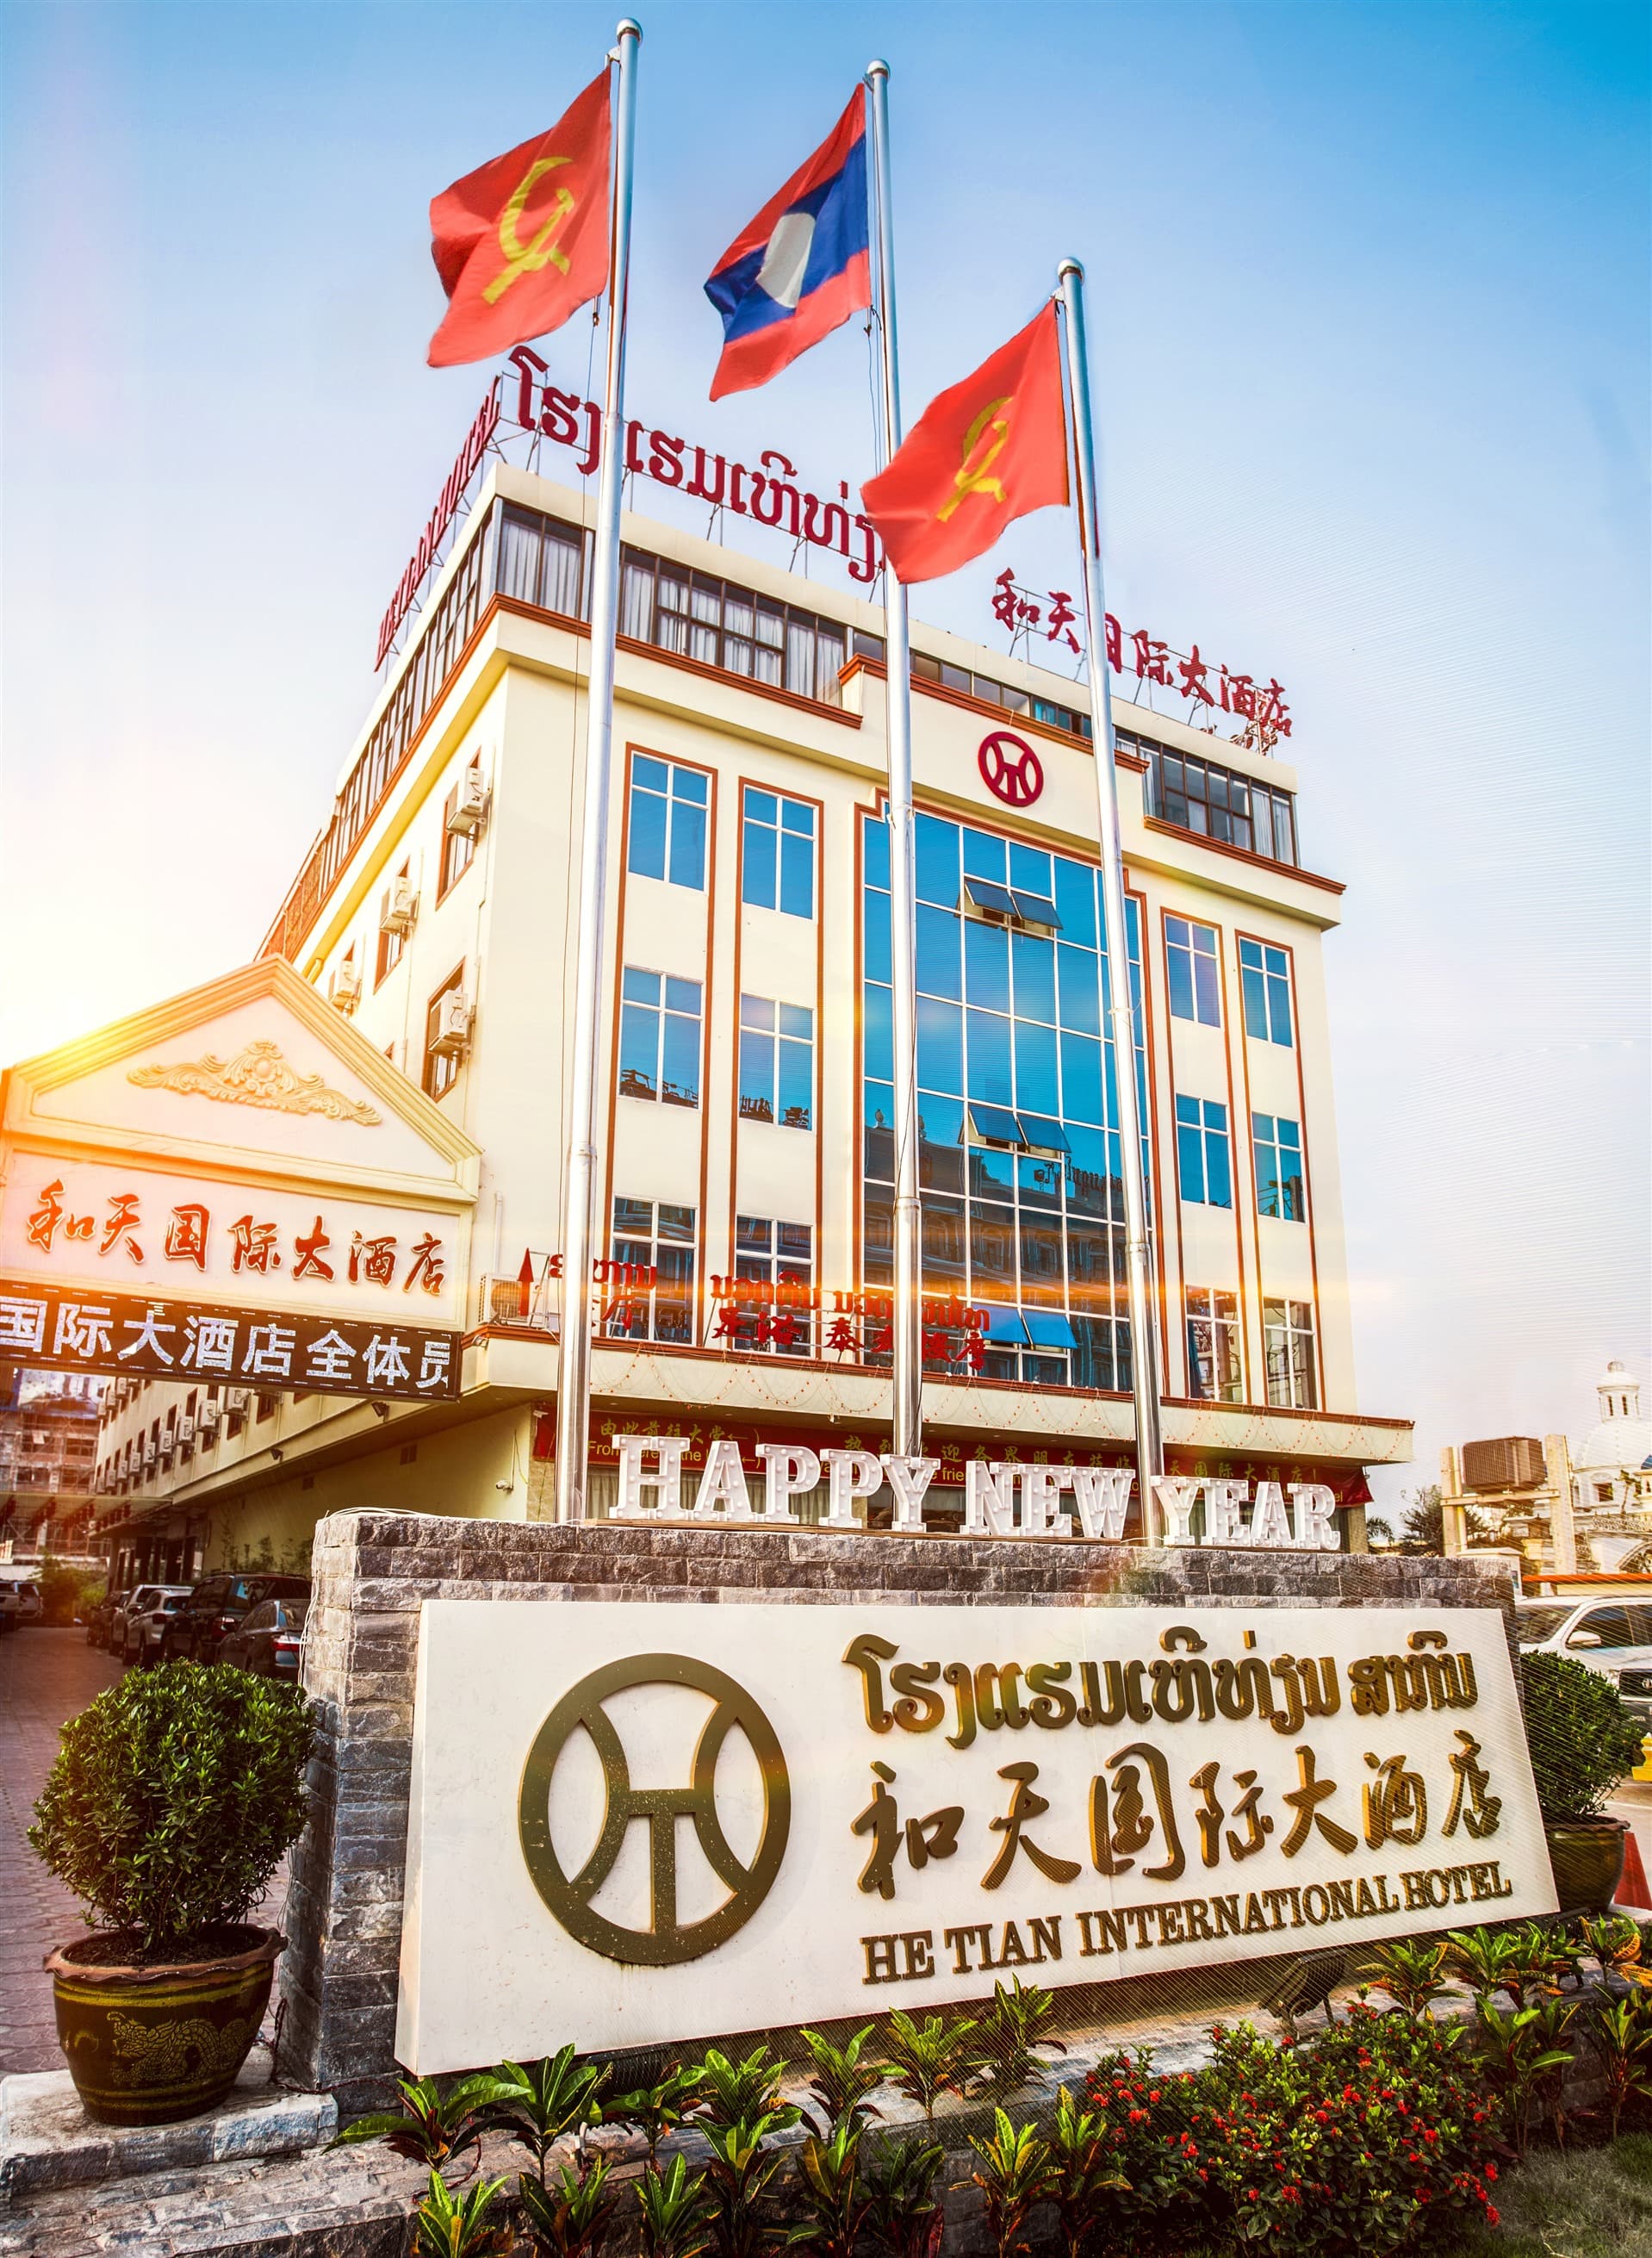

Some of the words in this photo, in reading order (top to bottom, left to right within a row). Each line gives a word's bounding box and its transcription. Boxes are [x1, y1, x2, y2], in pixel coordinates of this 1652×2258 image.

[509, 345, 885, 582] ໂຮງຮມເຫີທ່ຽ
[27, 1179, 447, 1296] 和天国际大酒店
[0, 1297, 450, 1390] 国际大酒店全体员
[608, 1434, 941, 1533] HAPPY
[960, 1460, 1136, 1540] NEW
[1150, 1475, 1341, 1550] YEAR
[1347, 1630, 1480, 1716] ສາກົນ
[850, 1728, 1503, 1900] 和天国际大酒店
[860, 1929, 935, 1986] HE
[944, 1914, 1063, 1975] TIAN
[1075, 1874, 1400, 1957] INTERNATIONAL
[1399, 1860, 1513, 1912] HOTEL
